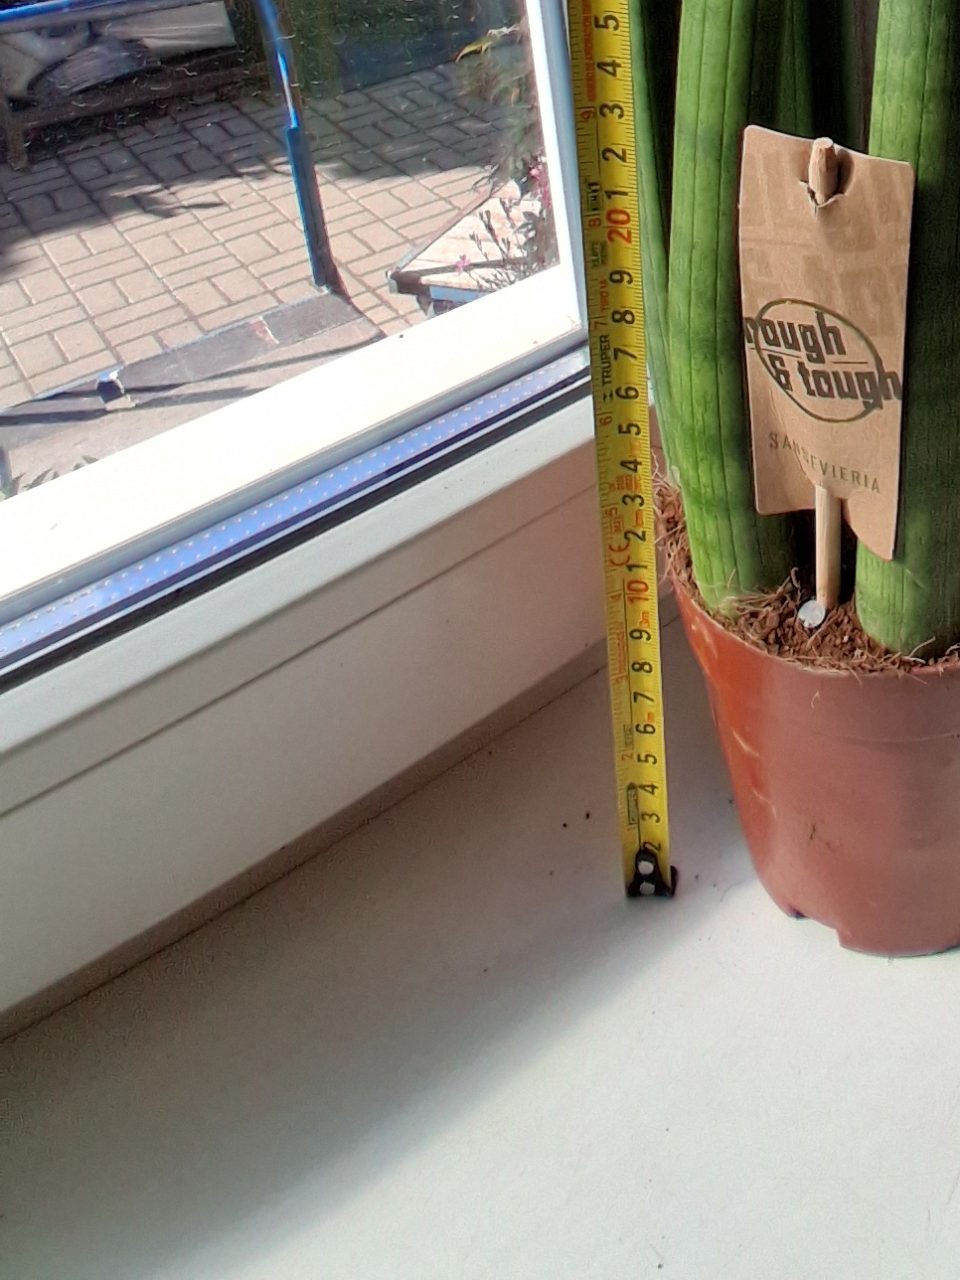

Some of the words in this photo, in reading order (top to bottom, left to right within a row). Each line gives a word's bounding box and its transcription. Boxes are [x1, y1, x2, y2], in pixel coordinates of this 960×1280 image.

[594, 15, 620, 31] 5
[597, 60, 622, 78] 4
[580, 110, 595, 121] 9
[599, 103, 624, 119] 3
[602, 147, 627, 163] 2
[604, 189, 629, 199] 1
[588, 217, 602, 228] 8
[606, 208, 632, 245] 20
[609, 270, 633, 285] 9
[611, 309, 635, 325] 8
[744, 310, 846, 364] rough
[599, 335, 612, 386] TRUPER
[614, 347, 637, 361] 7
[768, 353, 793, 392] &
[797, 361, 902, 410] tough
[615, 386, 640, 400] 6
[600, 416, 613, 426] 6
[618, 423, 641, 436] 5
[620, 459, 642, 473] 4
[622, 494, 644, 507] 3
[624, 530, 646, 542] 2
[627, 580, 649, 604] 10
[629, 629, 651, 641] 9
[631, 662, 653, 674] 8
[634, 691, 655, 703] 7
[636, 723, 656, 735] 6
[637, 754, 657, 765] 5
[639, 784, 659, 796] 4
[641, 812, 661, 823] 3
